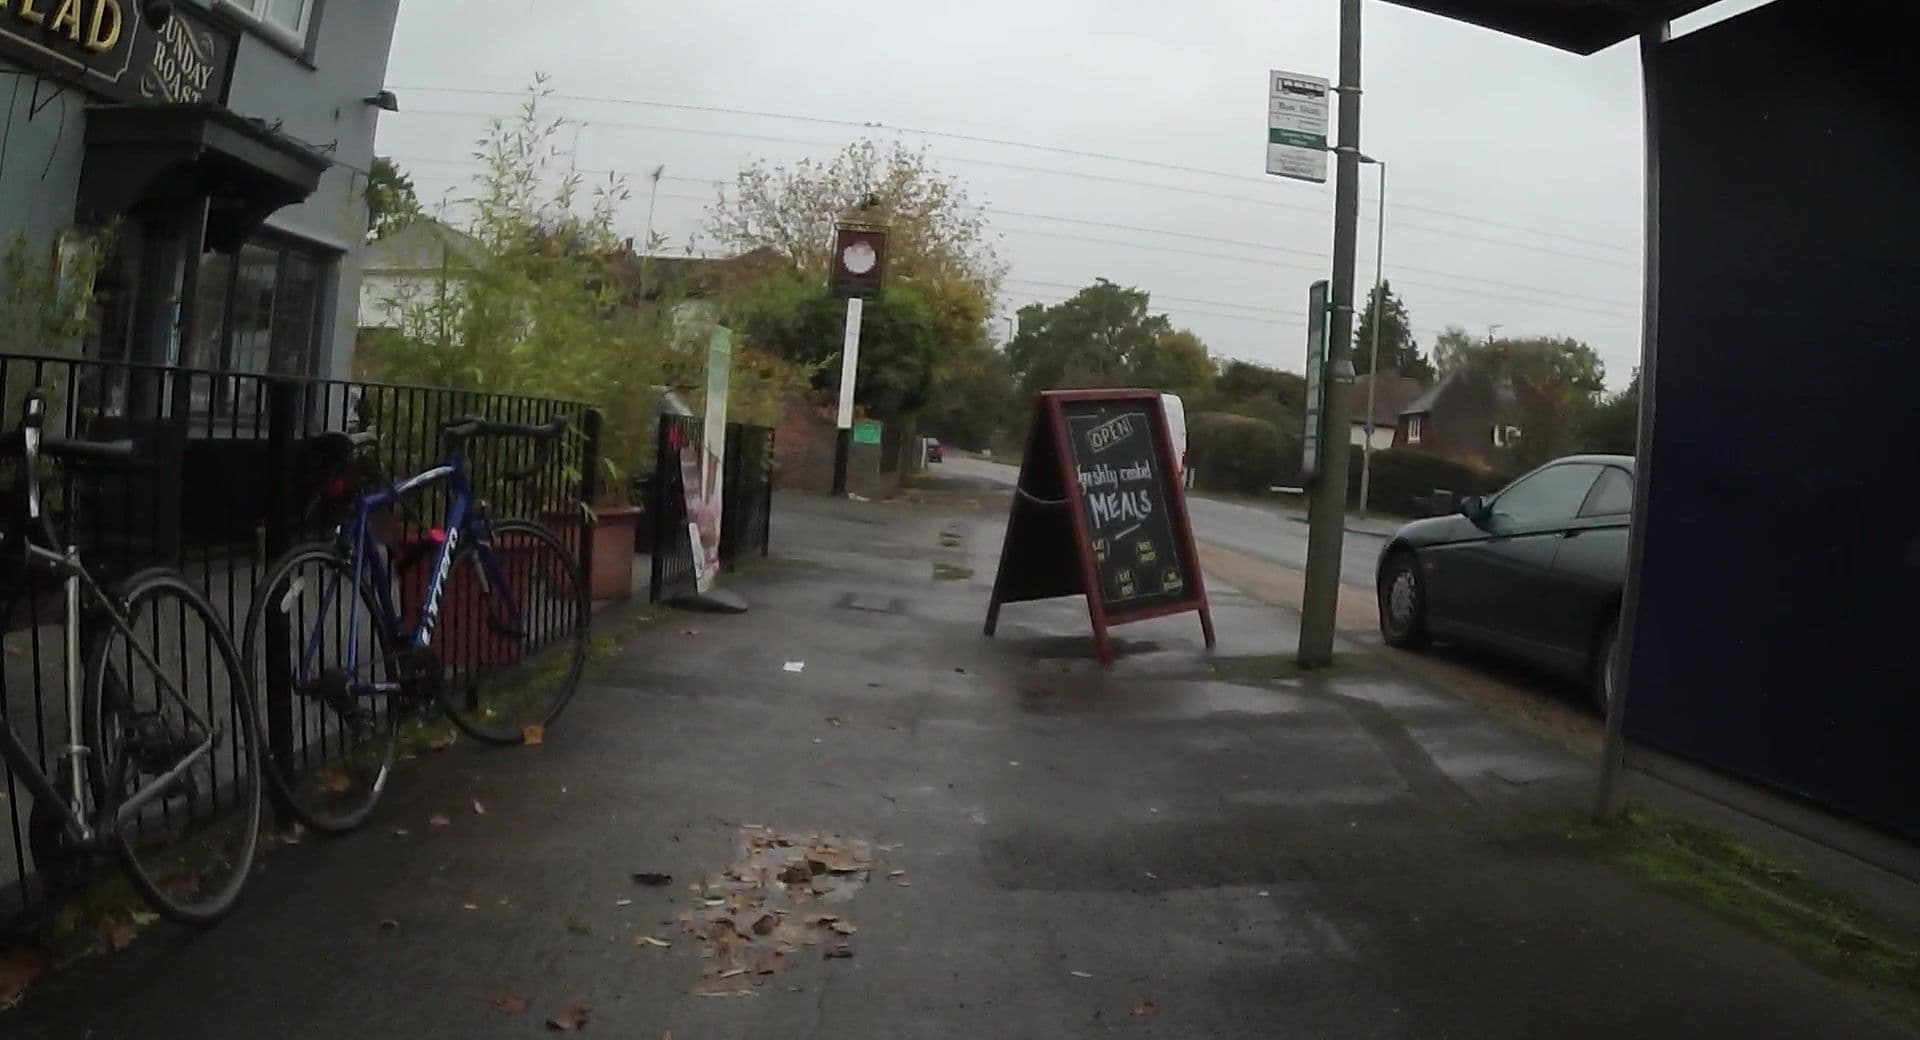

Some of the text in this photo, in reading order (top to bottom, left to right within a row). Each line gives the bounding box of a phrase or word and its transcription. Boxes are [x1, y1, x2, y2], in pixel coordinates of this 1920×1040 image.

[153, 40, 202, 103] ROAST
[1091, 418, 1130, 448] OPEN
[1090, 489, 1151, 528] MEALS
